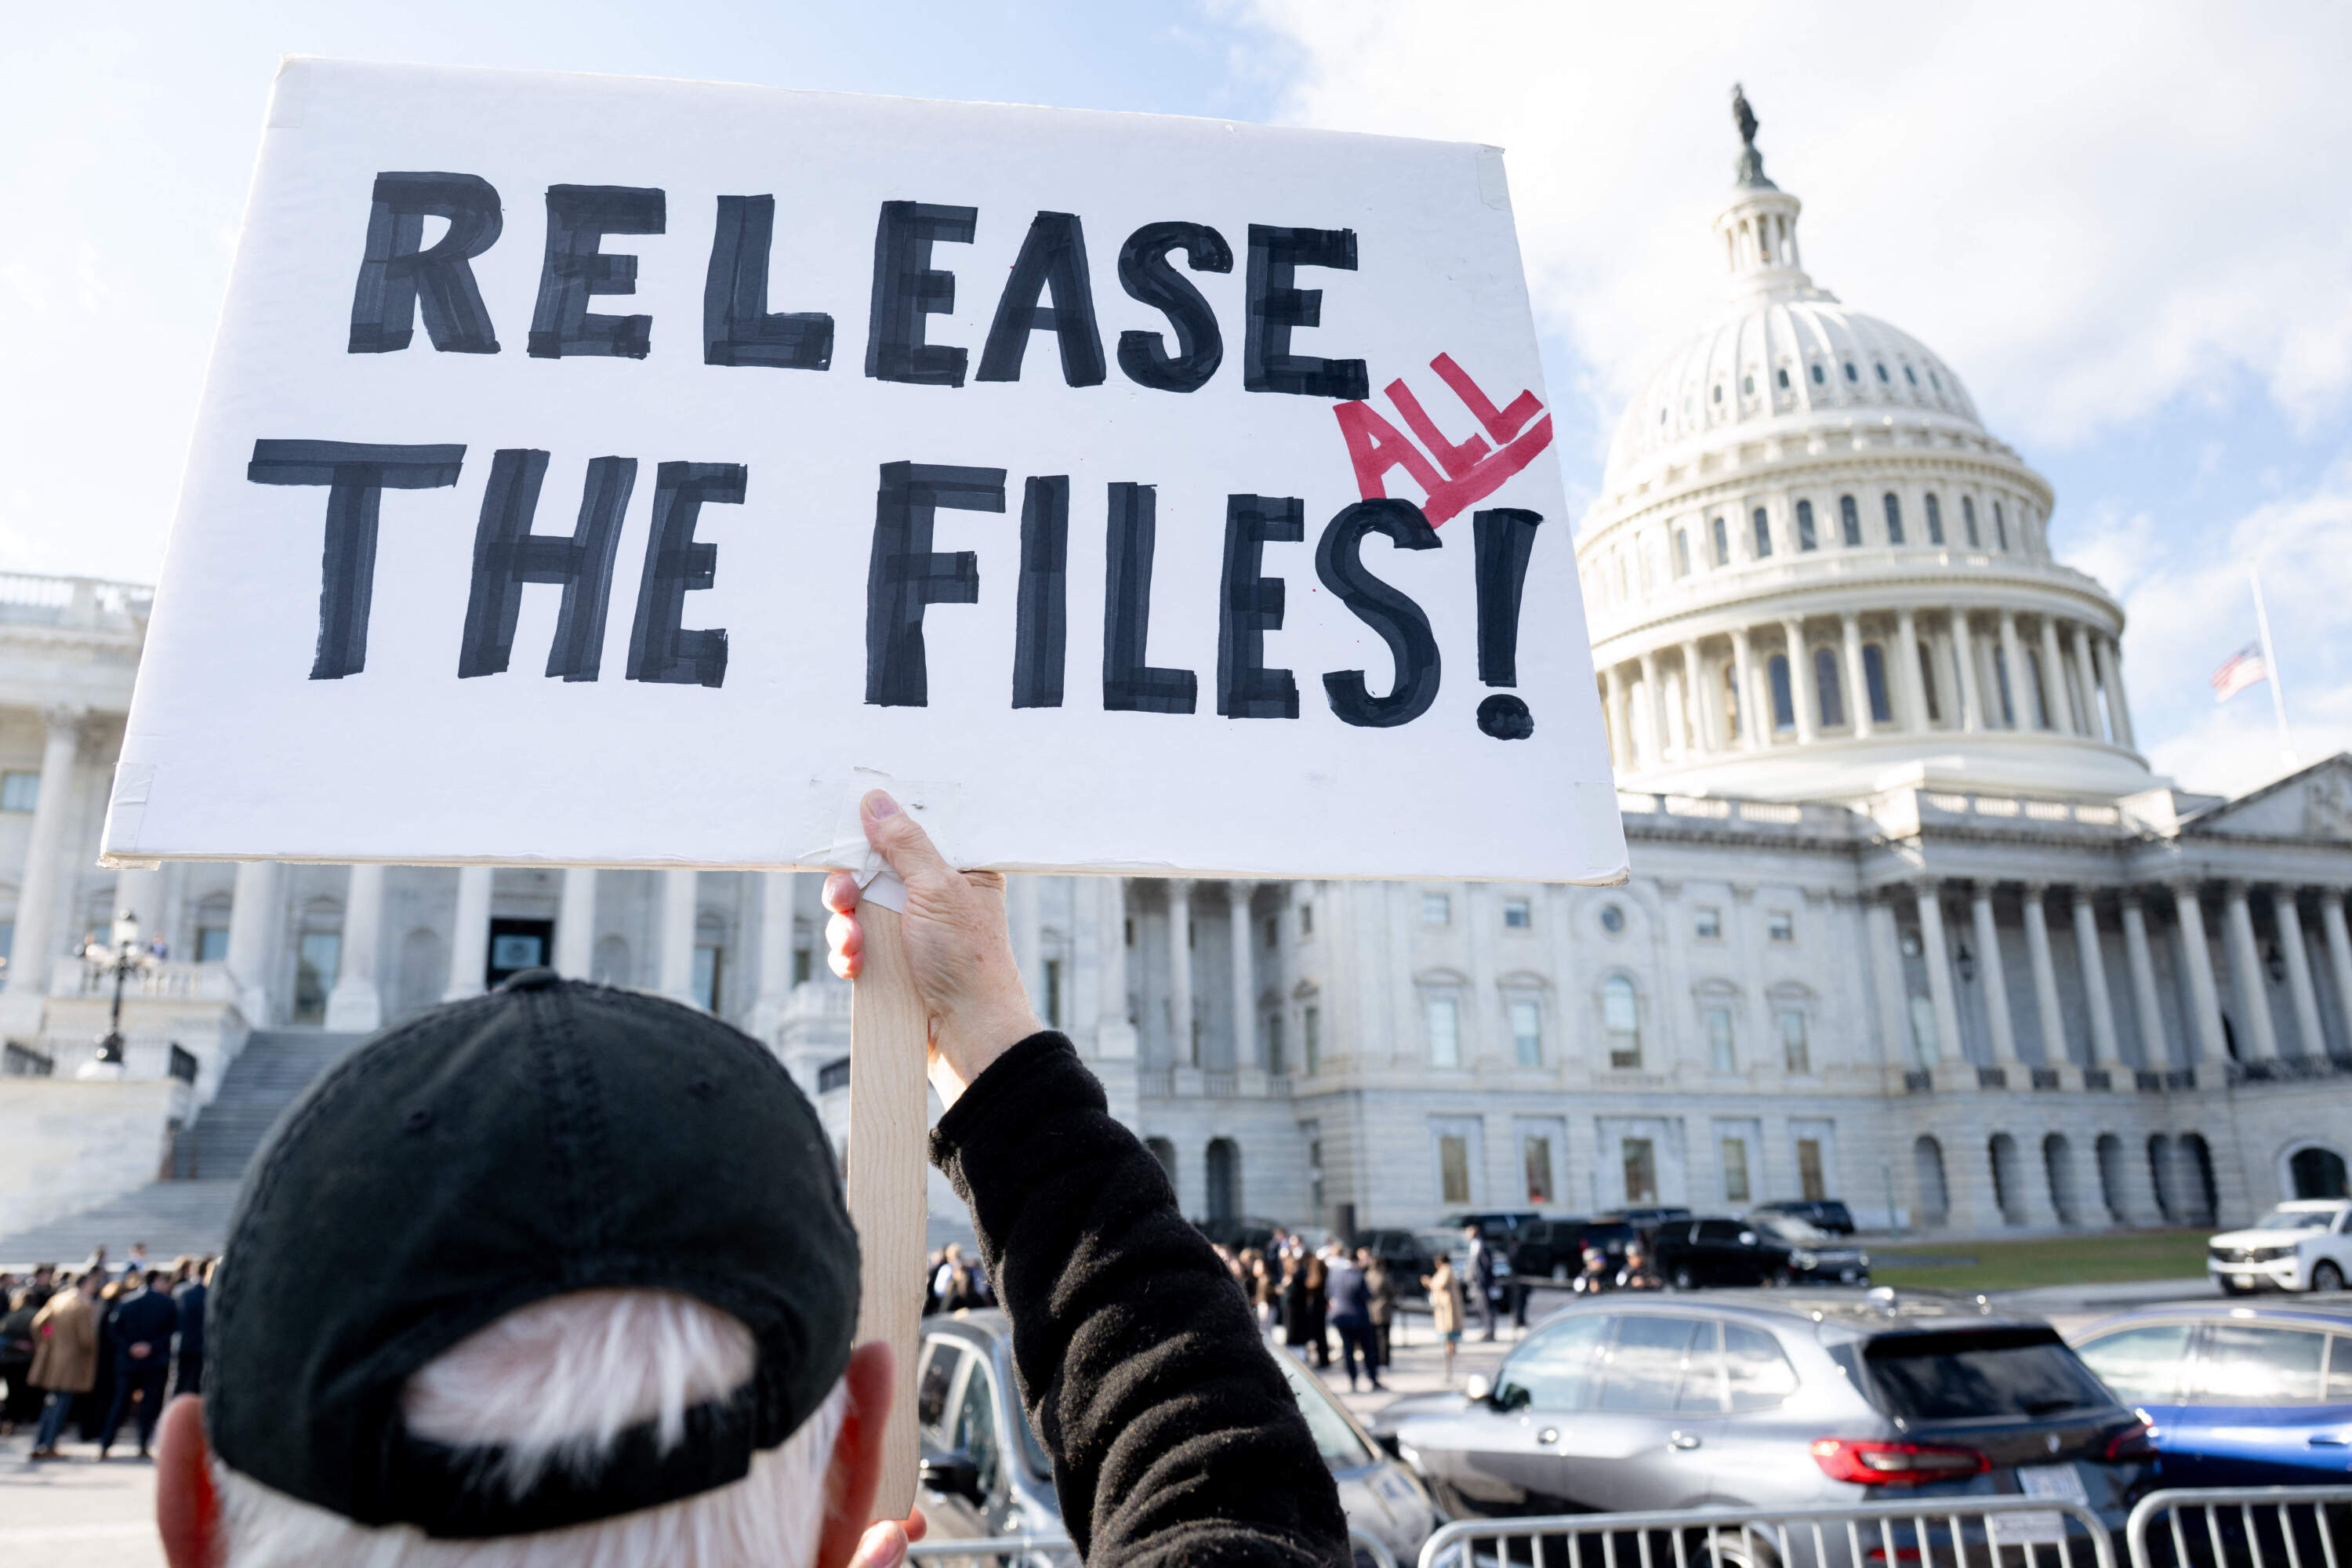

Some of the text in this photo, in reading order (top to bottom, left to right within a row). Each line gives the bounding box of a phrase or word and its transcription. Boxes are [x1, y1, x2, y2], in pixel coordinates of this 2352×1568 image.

[348, 171, 1370, 401] RELEASE
[1333, 352, 1544, 500] ALL
[248, 437, 1544, 740] THE FILES!
